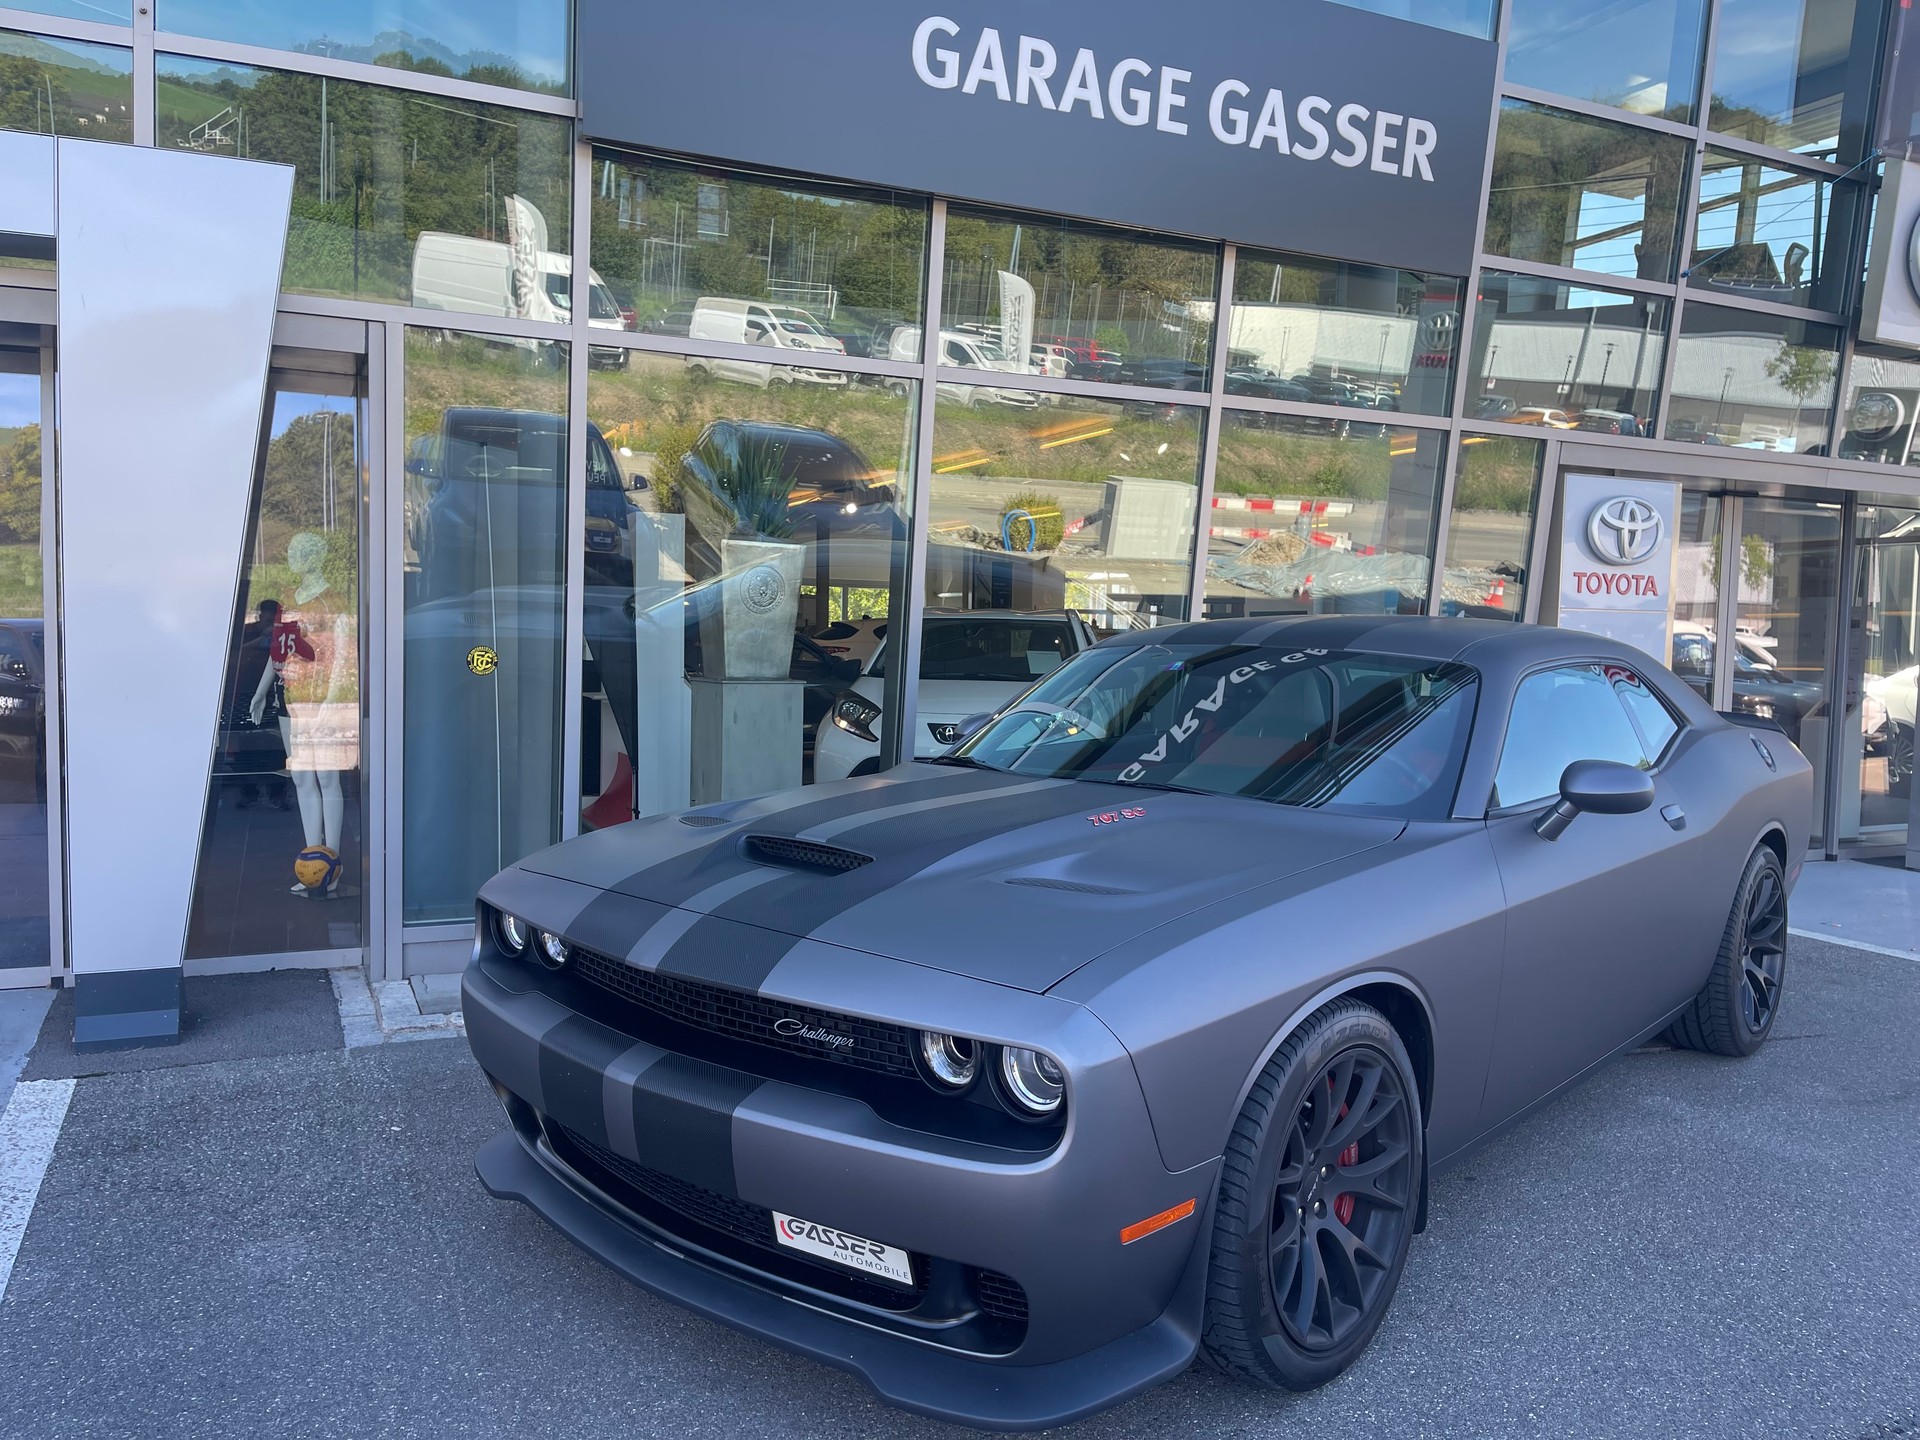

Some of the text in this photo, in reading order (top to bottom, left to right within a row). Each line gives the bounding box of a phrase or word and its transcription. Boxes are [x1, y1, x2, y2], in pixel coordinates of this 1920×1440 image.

[911, 16, 1438, 182] GARAGE GASSER
[1573, 572, 1659, 596] TOYOTA
[278, 633, 296, 655] 15
[1086, 811, 1119, 826] 707
[774, 1018, 855, 1049] Challenger
[787, 1218, 886, 1263] GASSER
[833, 1250, 909, 1280] AUTOMOBILE
